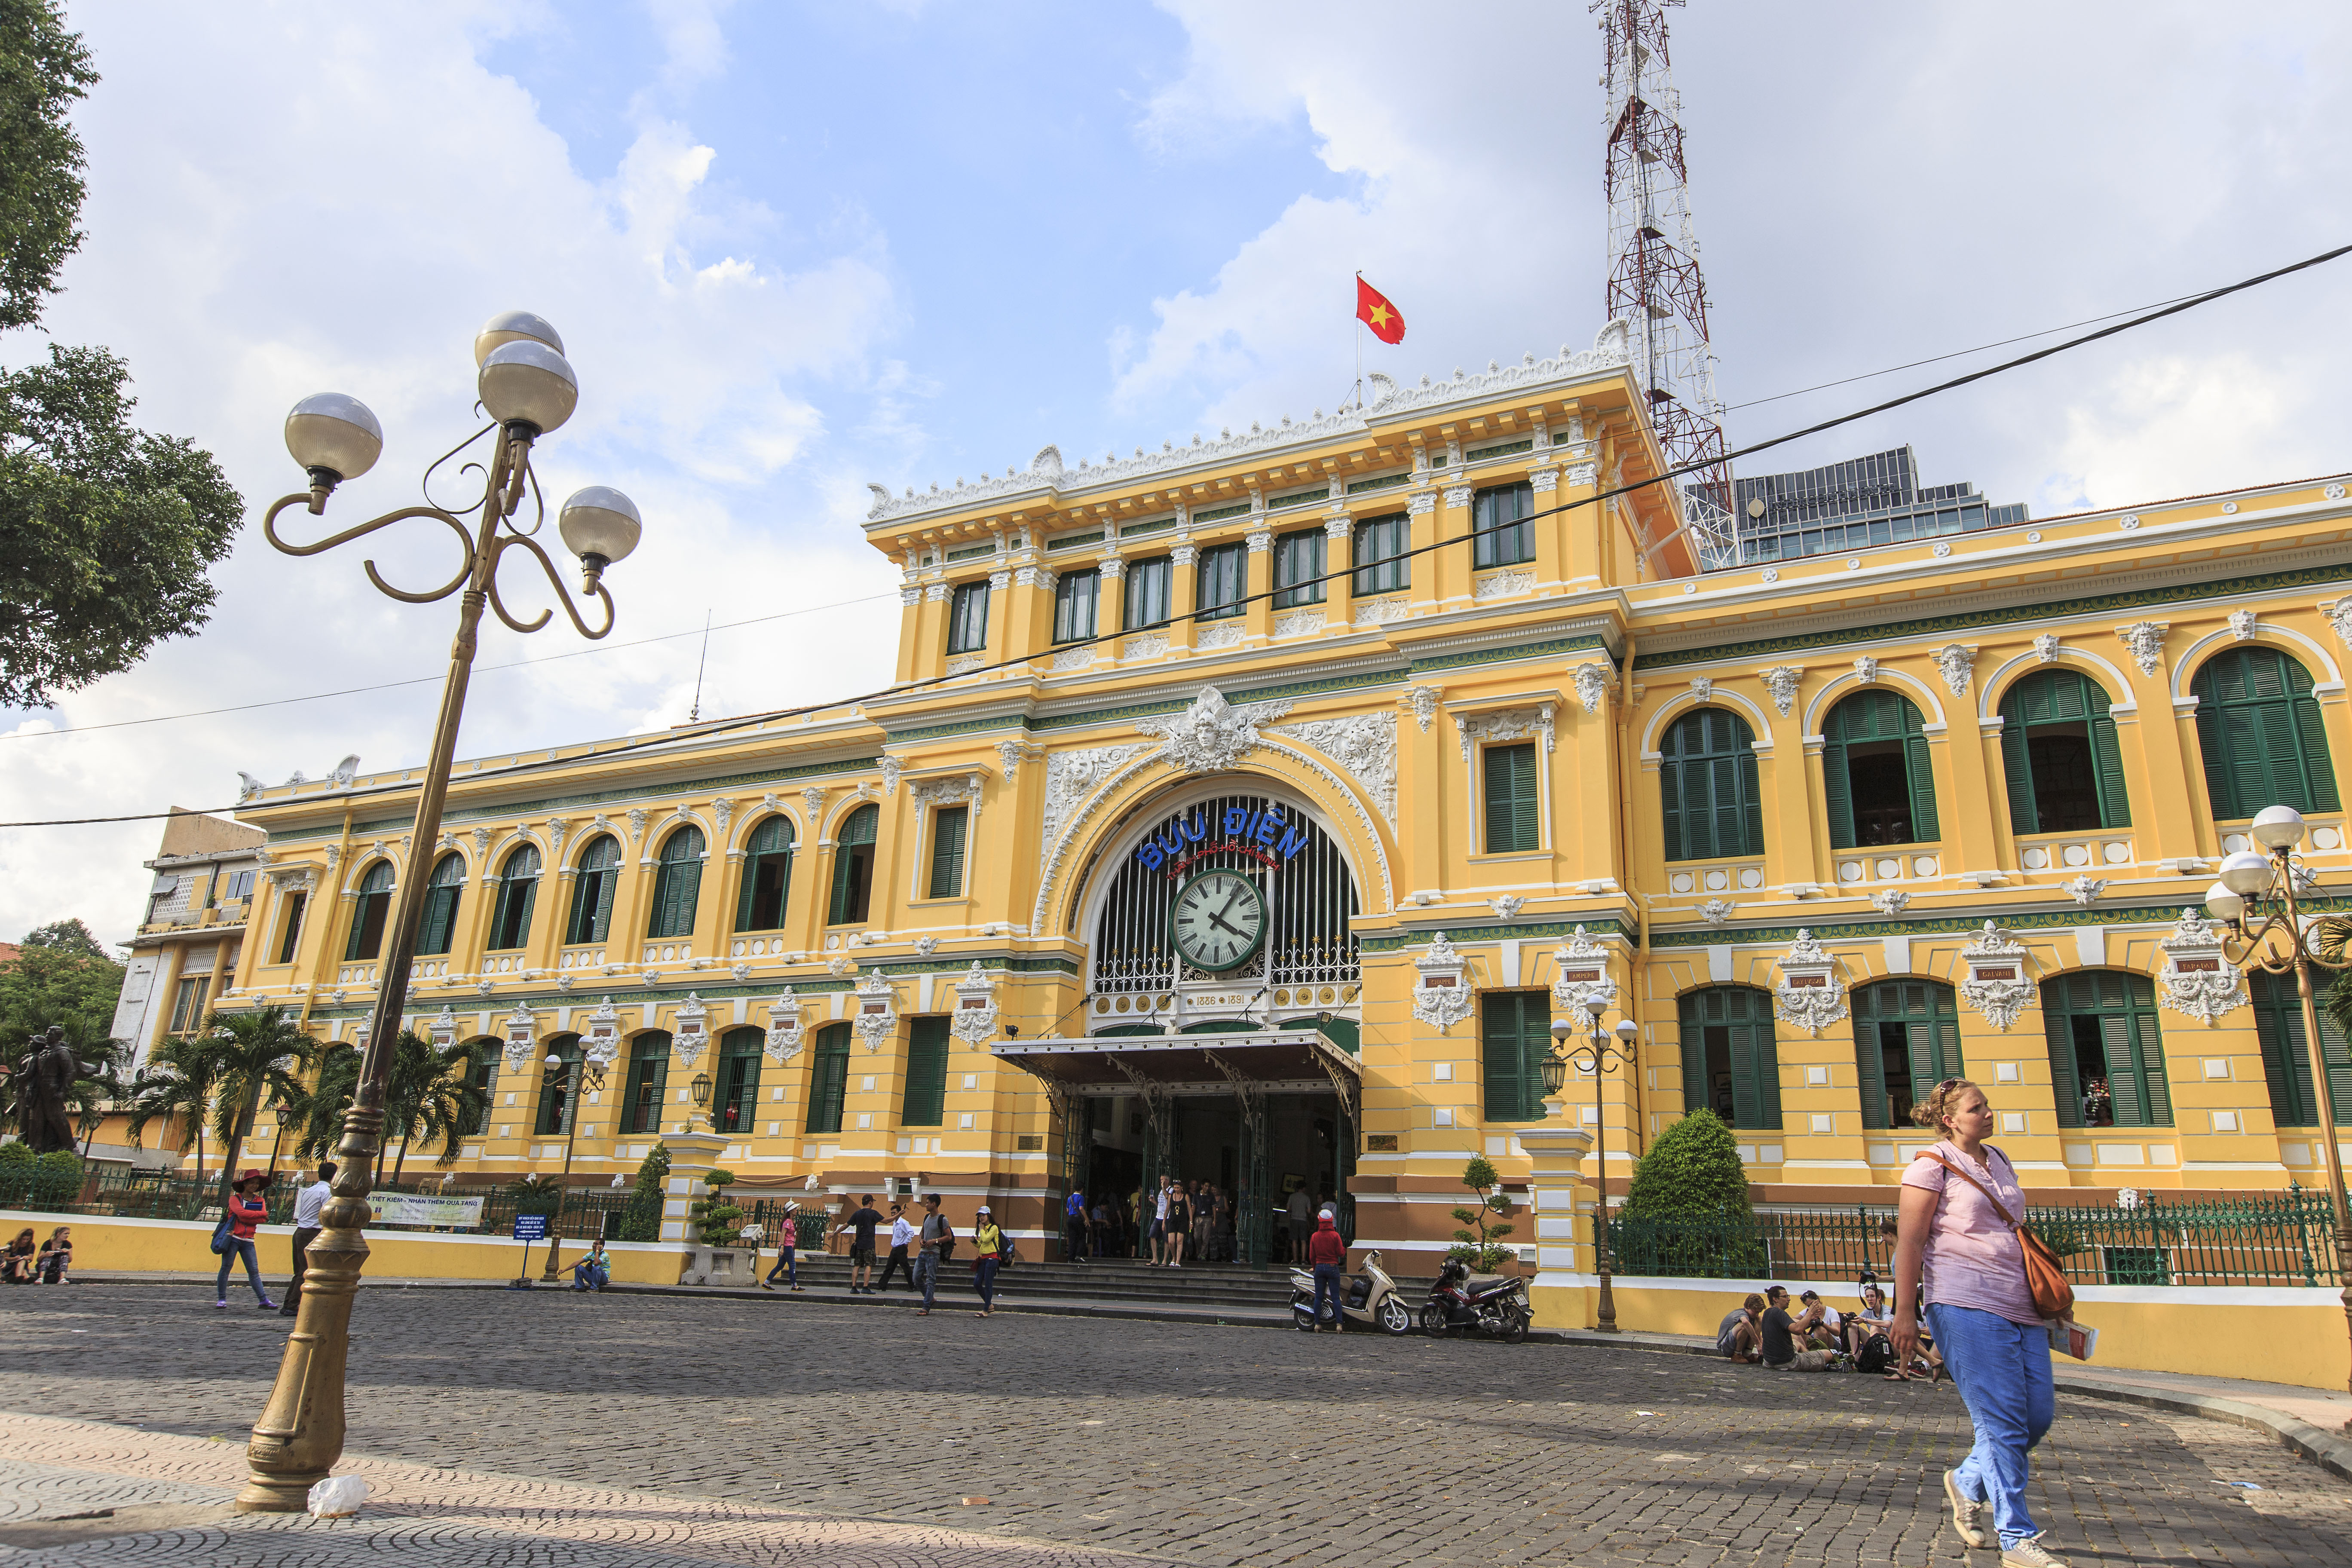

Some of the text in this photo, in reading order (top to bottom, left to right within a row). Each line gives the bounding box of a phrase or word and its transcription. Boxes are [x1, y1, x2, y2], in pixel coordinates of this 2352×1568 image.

[1771, 481, 1902, 511] INTERCONTINENTAL
[1136, 808, 1310, 871] BƯU ĐIỆN
[1166, 839, 1281, 880] THÀNH PHỐ HỒ CHÍ MINH
[1197, 995, 1244, 1005] 1886 1891
